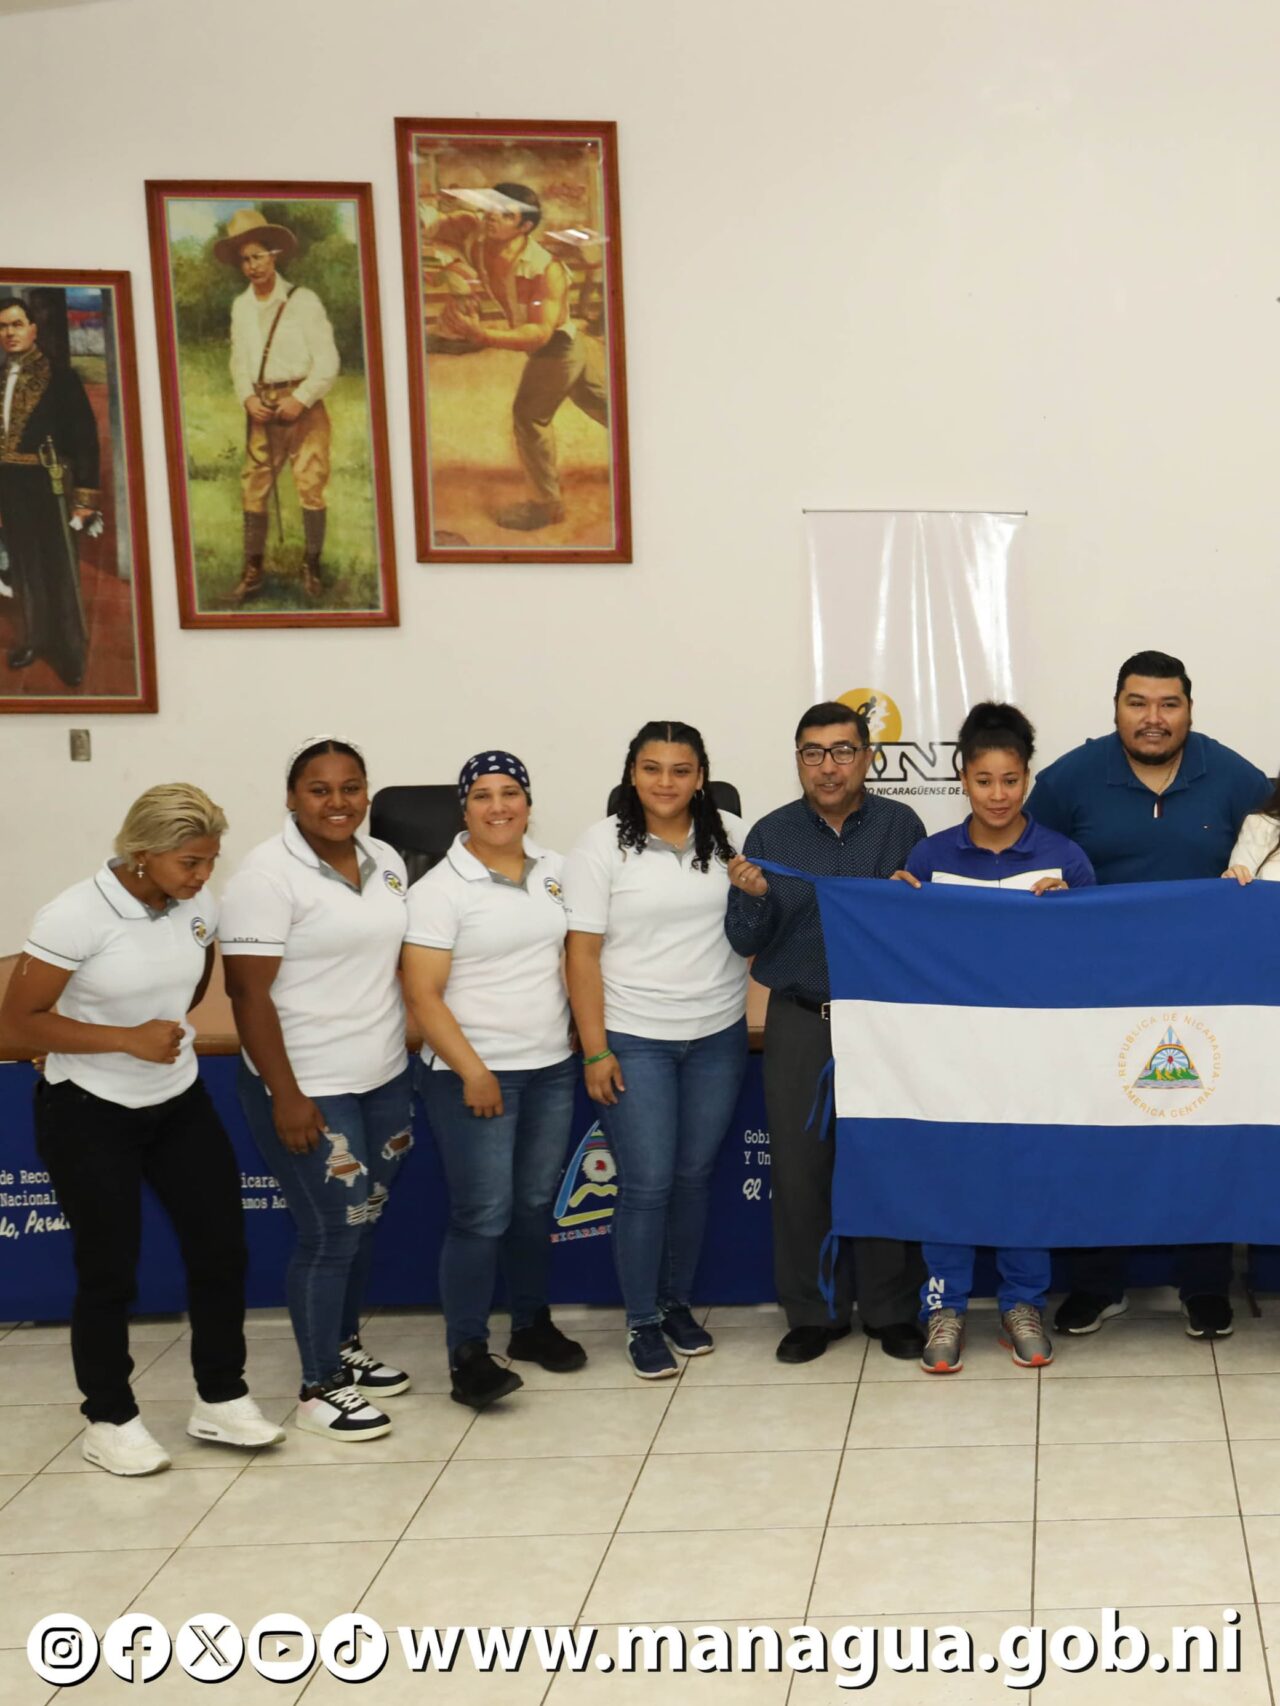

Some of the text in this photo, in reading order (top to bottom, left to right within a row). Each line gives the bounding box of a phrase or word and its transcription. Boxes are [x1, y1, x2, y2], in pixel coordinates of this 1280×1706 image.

[876, 786, 946, 796] NICARAGÜENSE
[948, 787, 960, 795] DE
[1163, 1013, 1178, 1022] DE
[1183, 1015, 1221, 1079] NICARAGUA
[1170, 1086, 1216, 1118] CENTRAL
[744, 1129, 770, 1144] Gobi
[744, 1151, 771, 1165] Y Un
[0, 1170, 50, 1185] de Reco
[0, 1189, 57, 1207] Nacional
